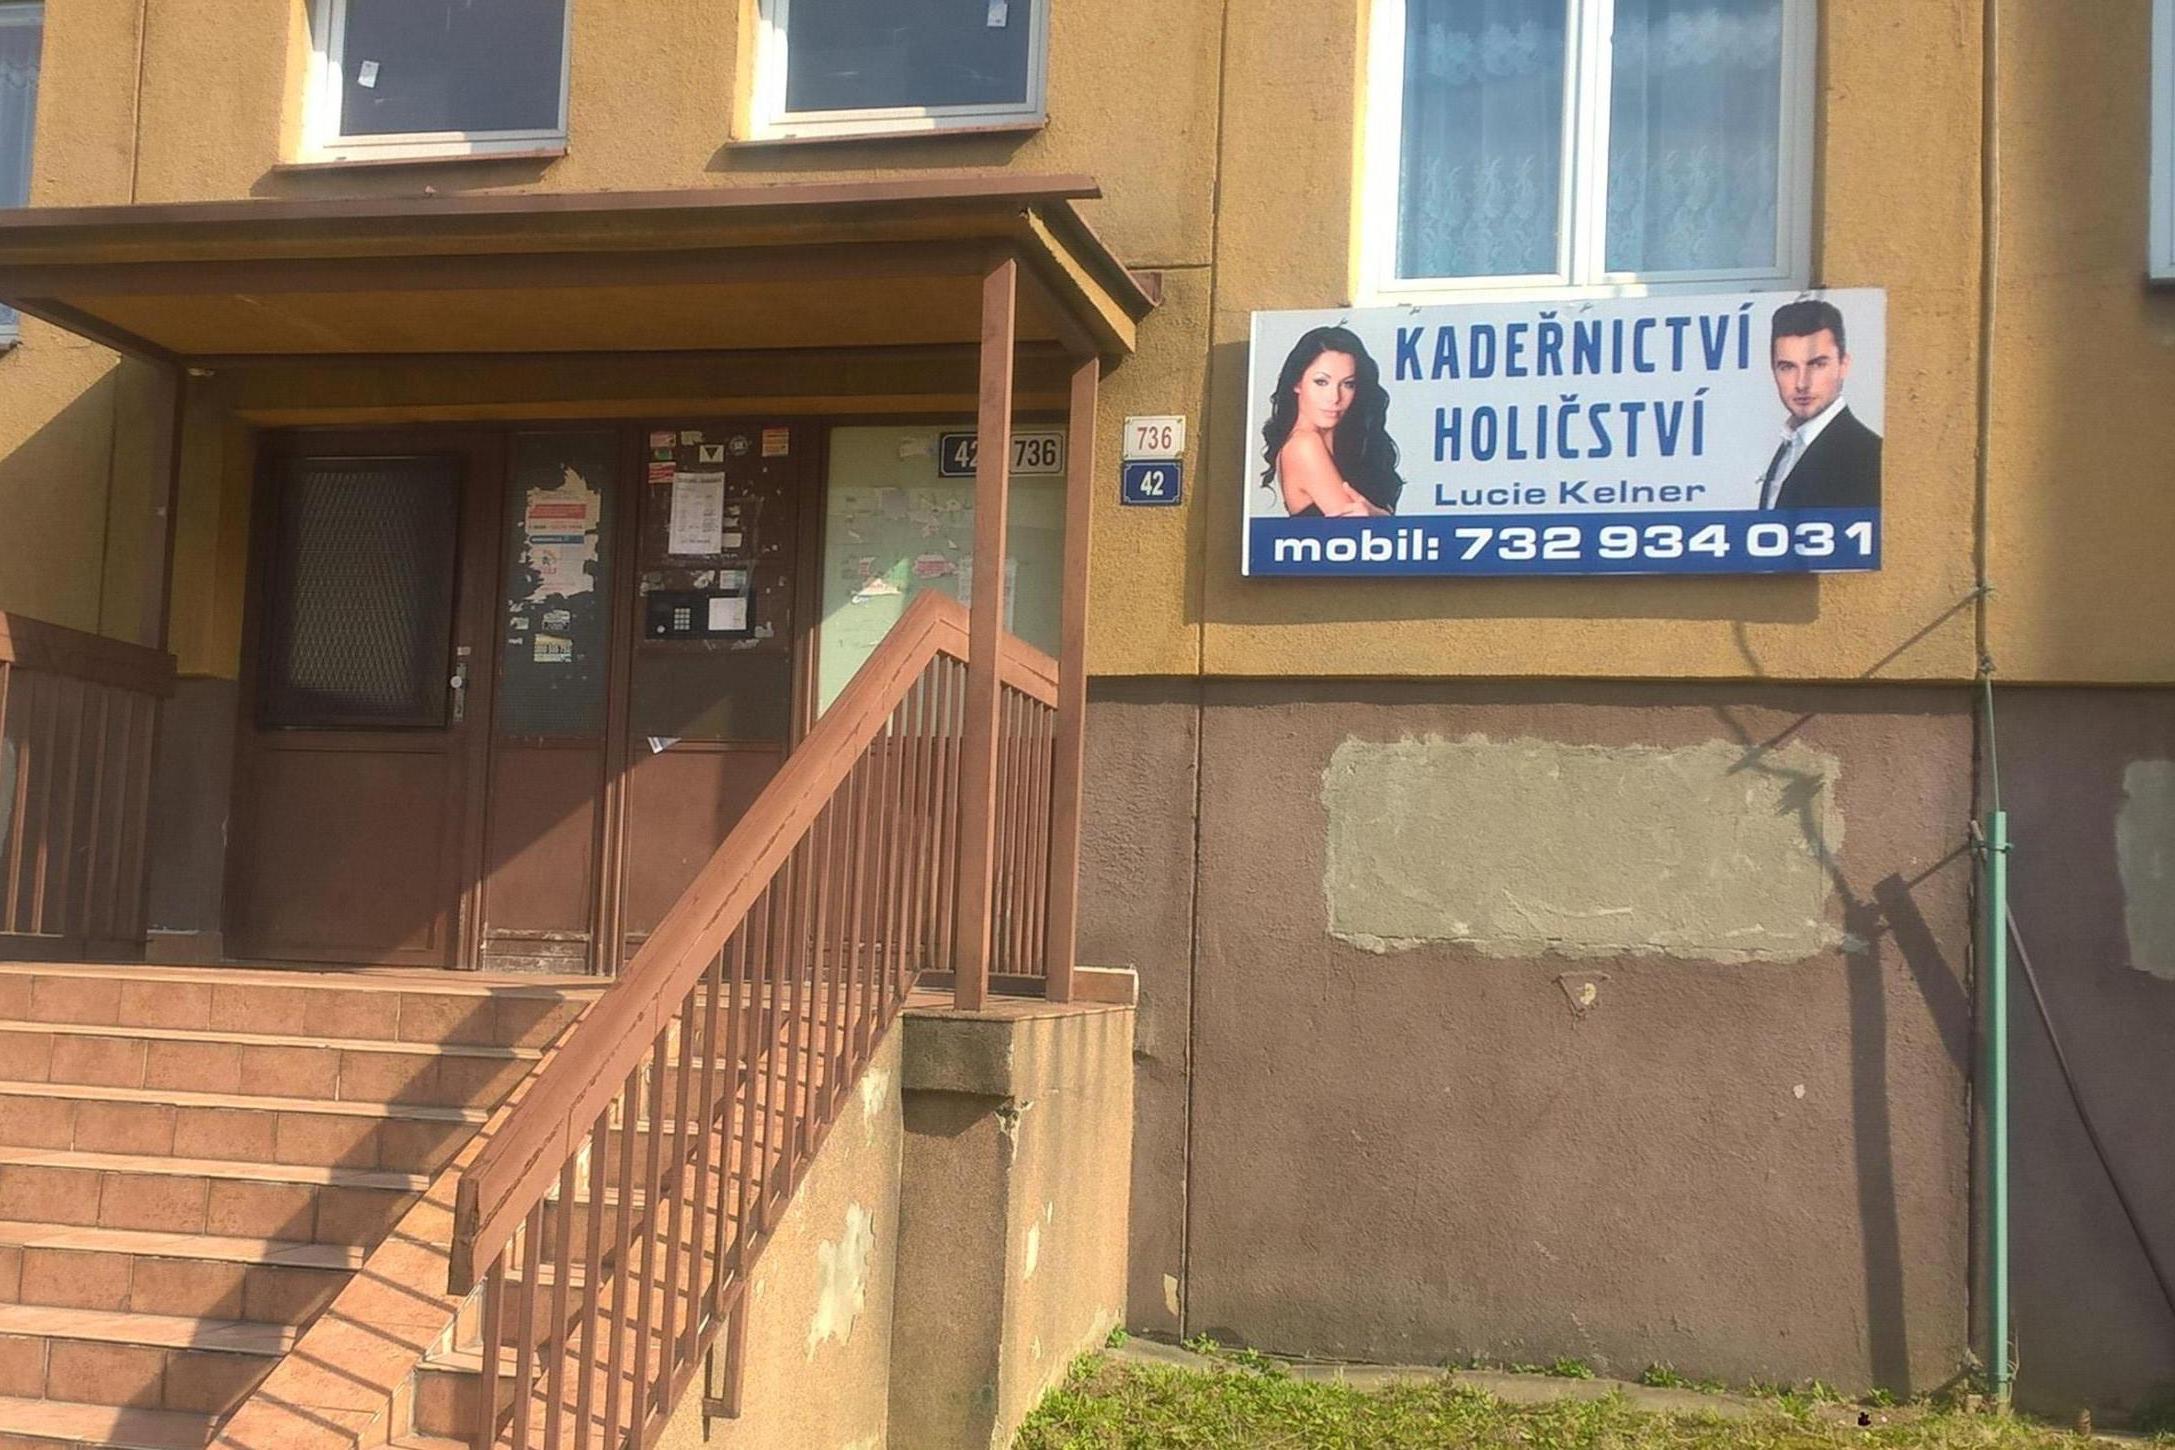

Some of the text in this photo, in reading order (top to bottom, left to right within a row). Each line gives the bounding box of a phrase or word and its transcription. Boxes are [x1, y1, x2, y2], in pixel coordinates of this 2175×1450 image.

[1395, 302, 1755, 381] KADEŘNICTVÍ
[1137, 426, 1172, 450] 736
[1434, 387, 1710, 463] HOLIČSTVÍ
[1014, 439, 1056, 467] 736
[1140, 470, 1164, 496] 42
[1434, 480, 1706, 506] Lucie Kelner
[1274, 521, 1873, 562] mobil: 732 934 031
